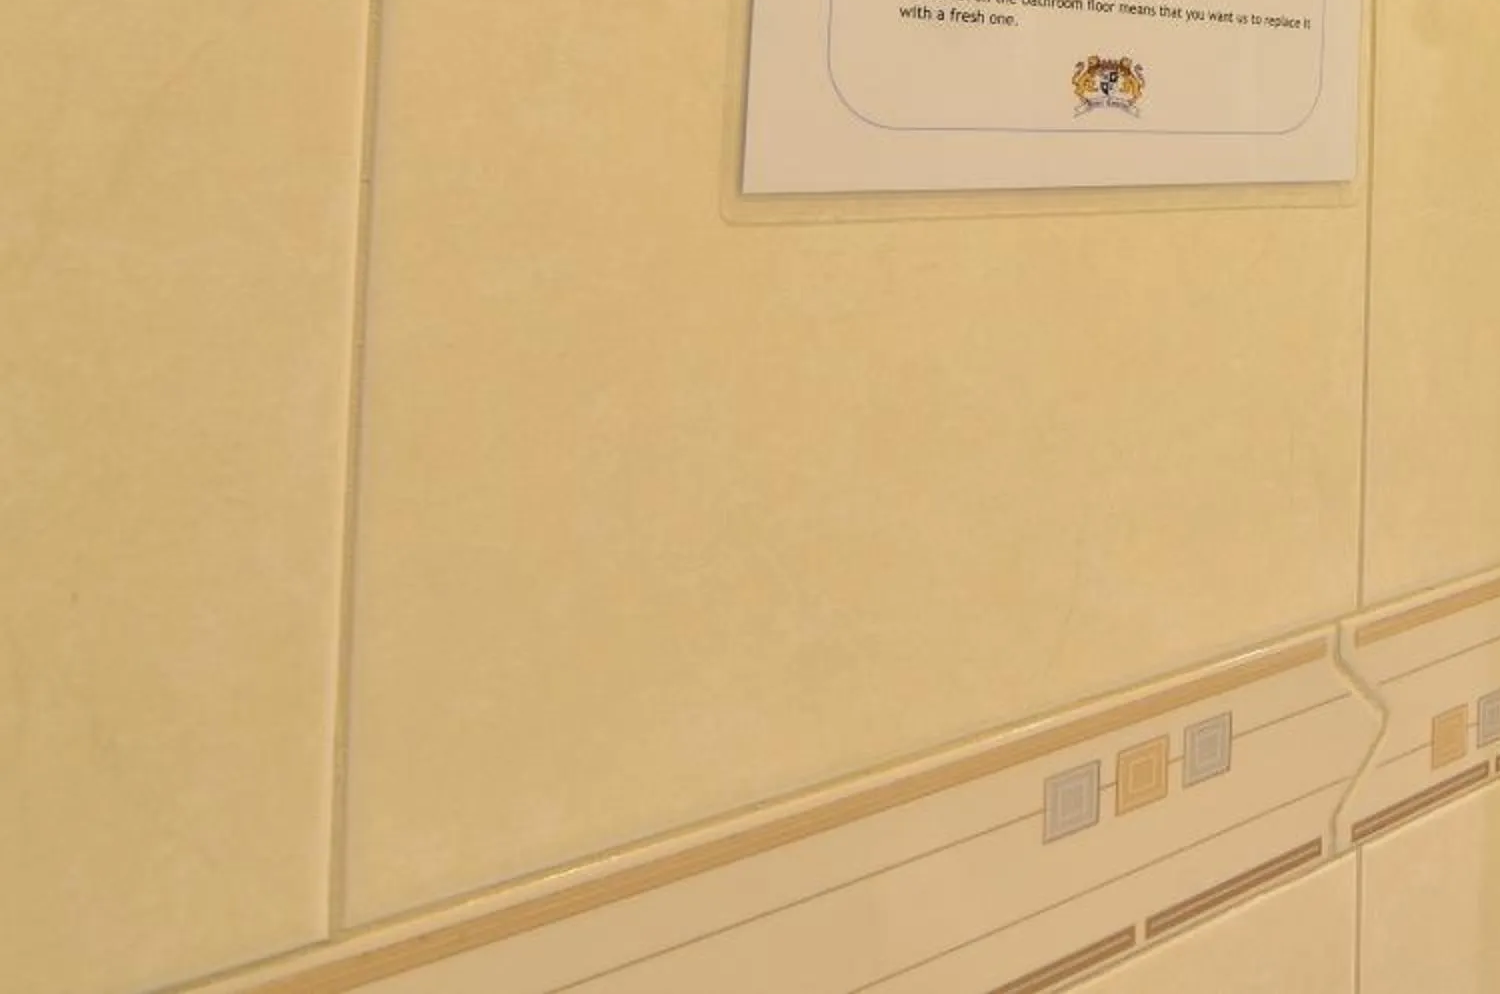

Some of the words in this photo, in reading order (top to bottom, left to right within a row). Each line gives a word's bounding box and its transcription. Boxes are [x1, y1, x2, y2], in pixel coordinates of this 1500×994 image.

[898, 5, 933, 20] with
[935, 8, 946, 22] a
[949, 7, 986, 24] fresh
[988, 13, 1019, 27] one.
[1118, 2, 1158, 18] means
[1158, 4, 1183, 19] that
[1207, 10, 1234, 24] want
[1250, 13, 1263, 26] to
